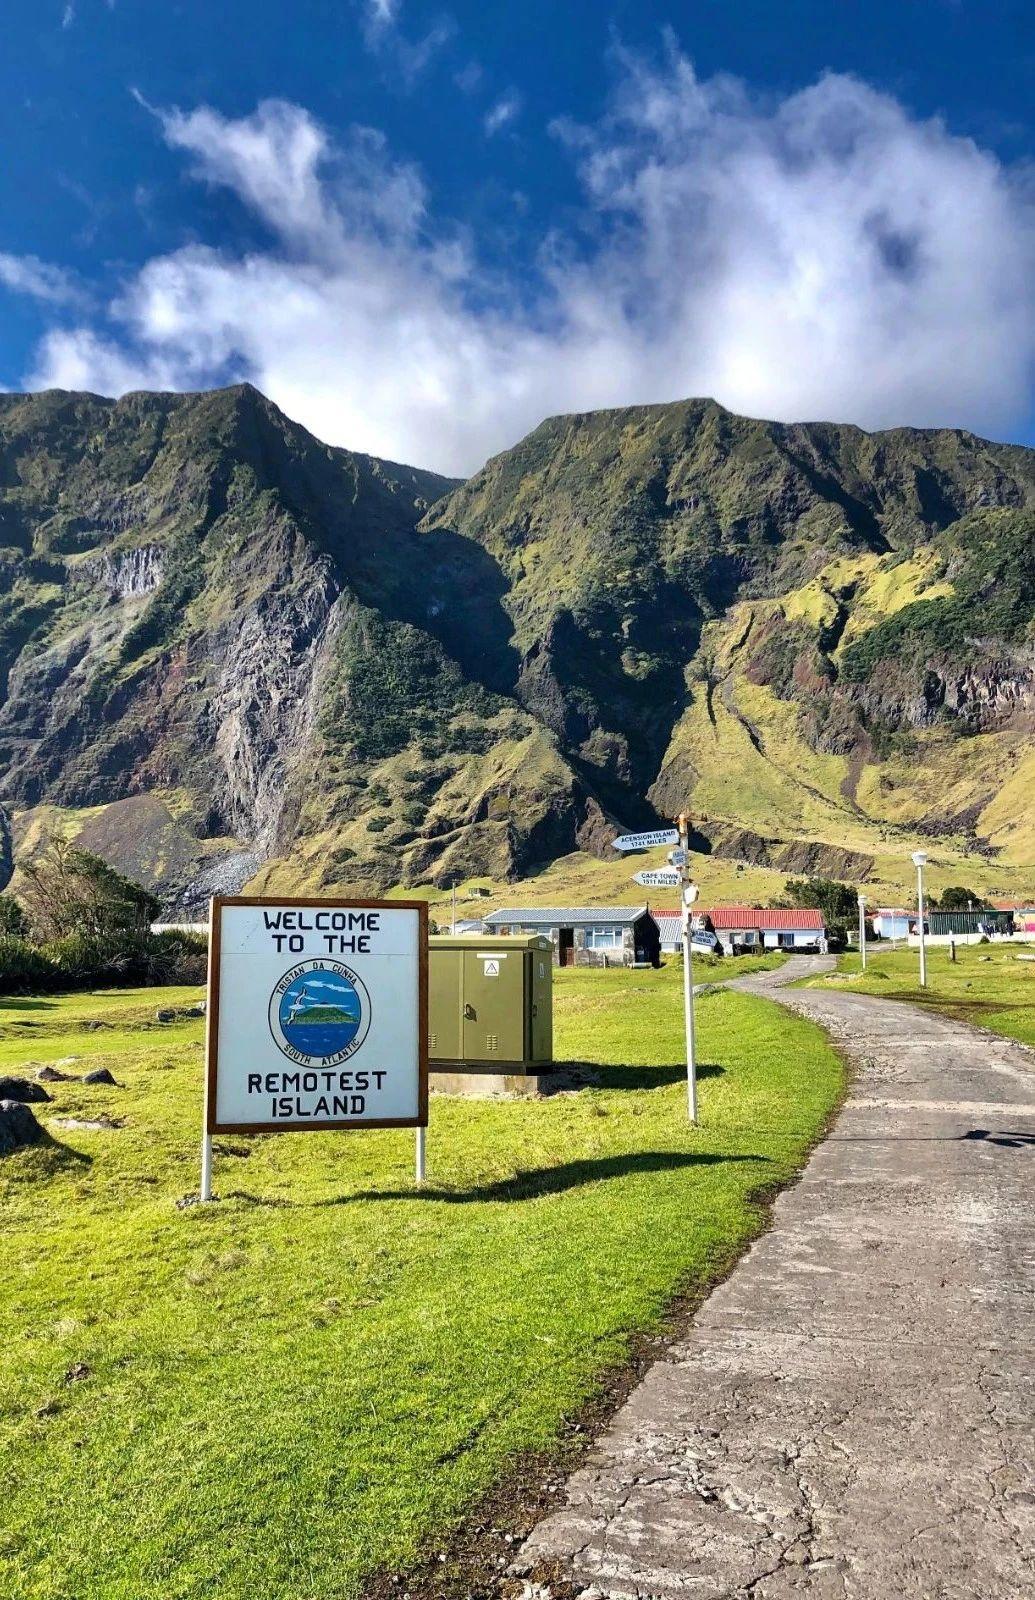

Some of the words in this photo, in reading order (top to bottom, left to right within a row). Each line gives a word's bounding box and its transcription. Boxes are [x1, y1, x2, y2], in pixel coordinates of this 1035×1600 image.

[621, 833, 652, 843] ACENSION
[653, 830, 676, 838] ISLAND
[263, 911, 380, 931] WELCOME
[272, 934, 305, 953] TO
[323, 935, 371, 953] THE
[276, 966, 305, 995] TRISTAN
[312, 962, 325, 970] DA
[332, 964, 358, 986] CUNHA
[283, 1044, 311, 1065] SOUTH
[321, 1038, 360, 1066] ATLANTIC
[247, 1071, 387, 1094] REMOTEST
[272, 1095, 365, 1118] ISLAND
